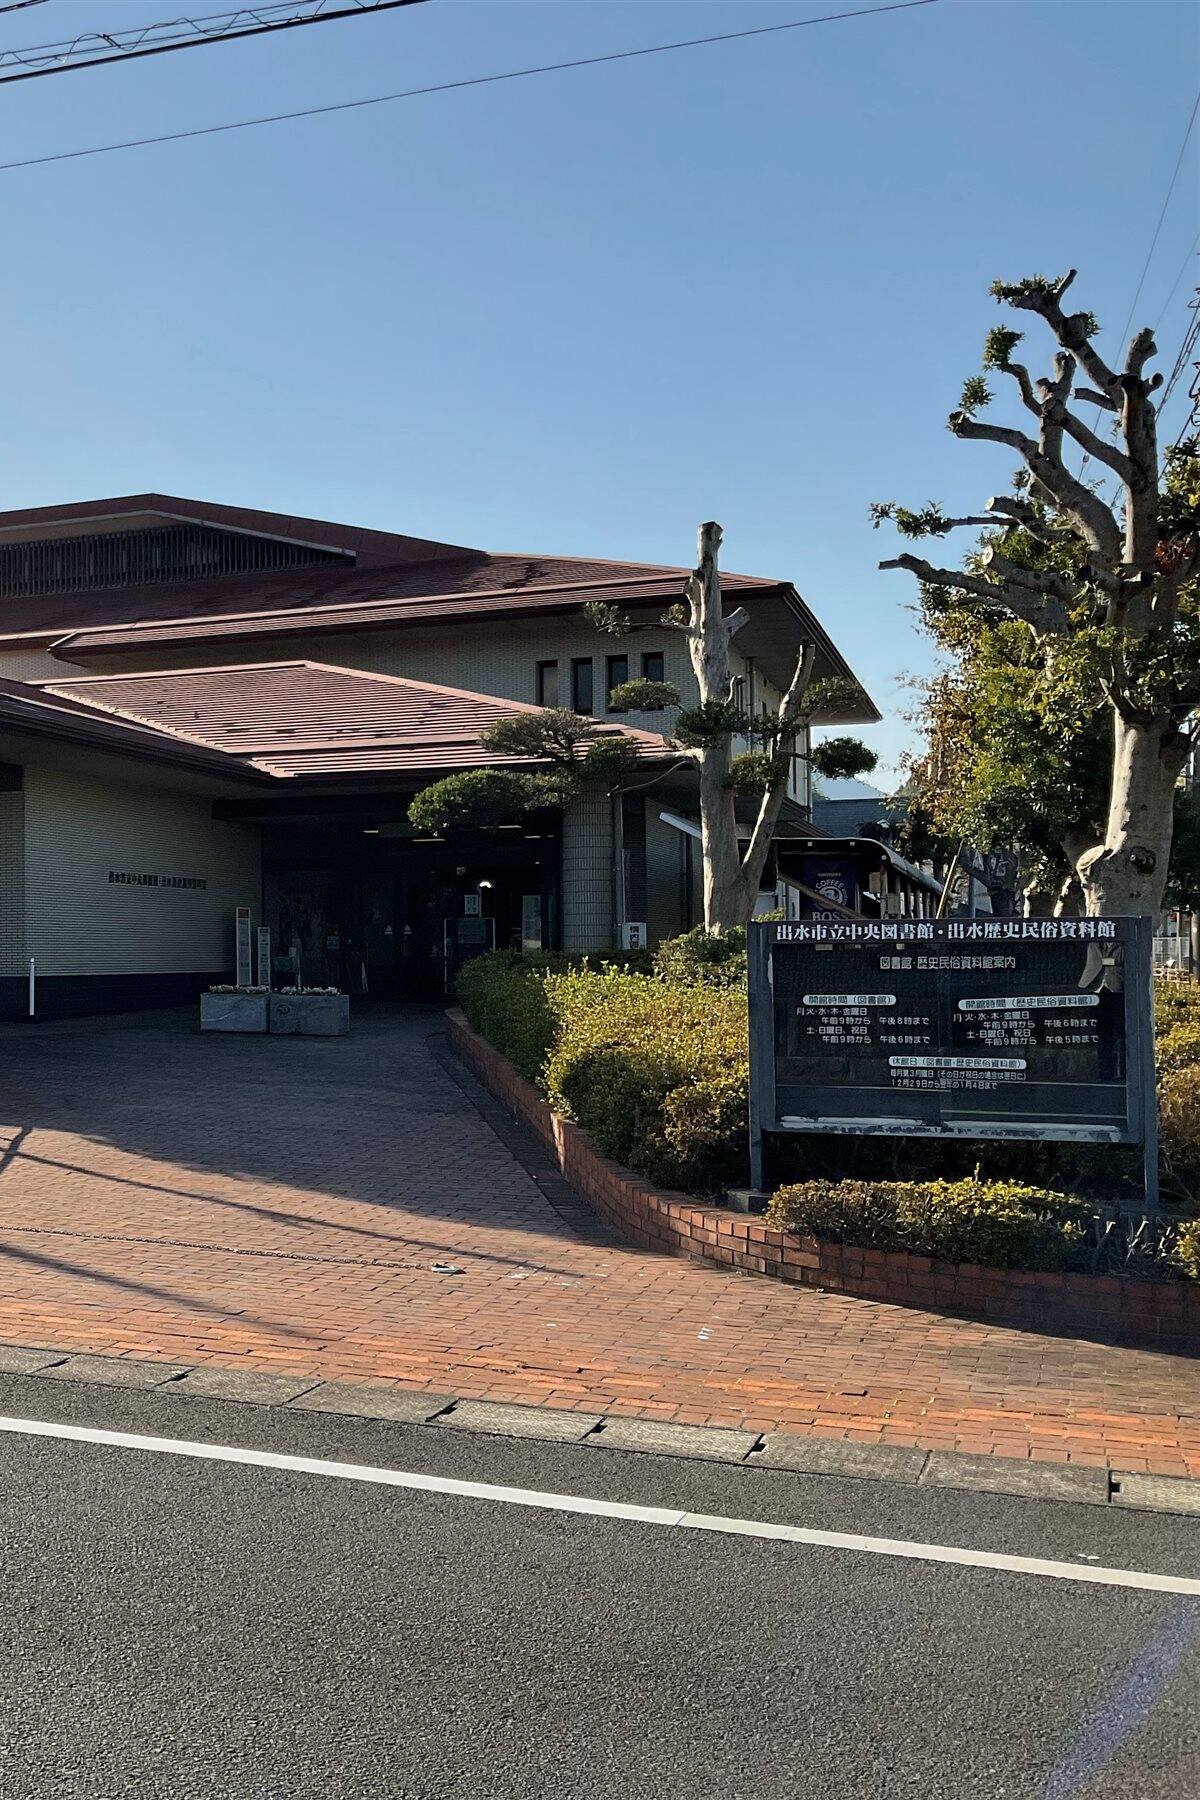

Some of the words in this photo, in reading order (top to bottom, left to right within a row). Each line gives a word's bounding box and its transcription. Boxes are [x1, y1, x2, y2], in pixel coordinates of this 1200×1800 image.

[815, 879, 845, 889] COFFEE
[776, 921, 1116, 941] 出水市立中央図書館・出水歴史民俗資料館
[880, 956, 1016, 970] 図書館・歴史民俗資料館案内
